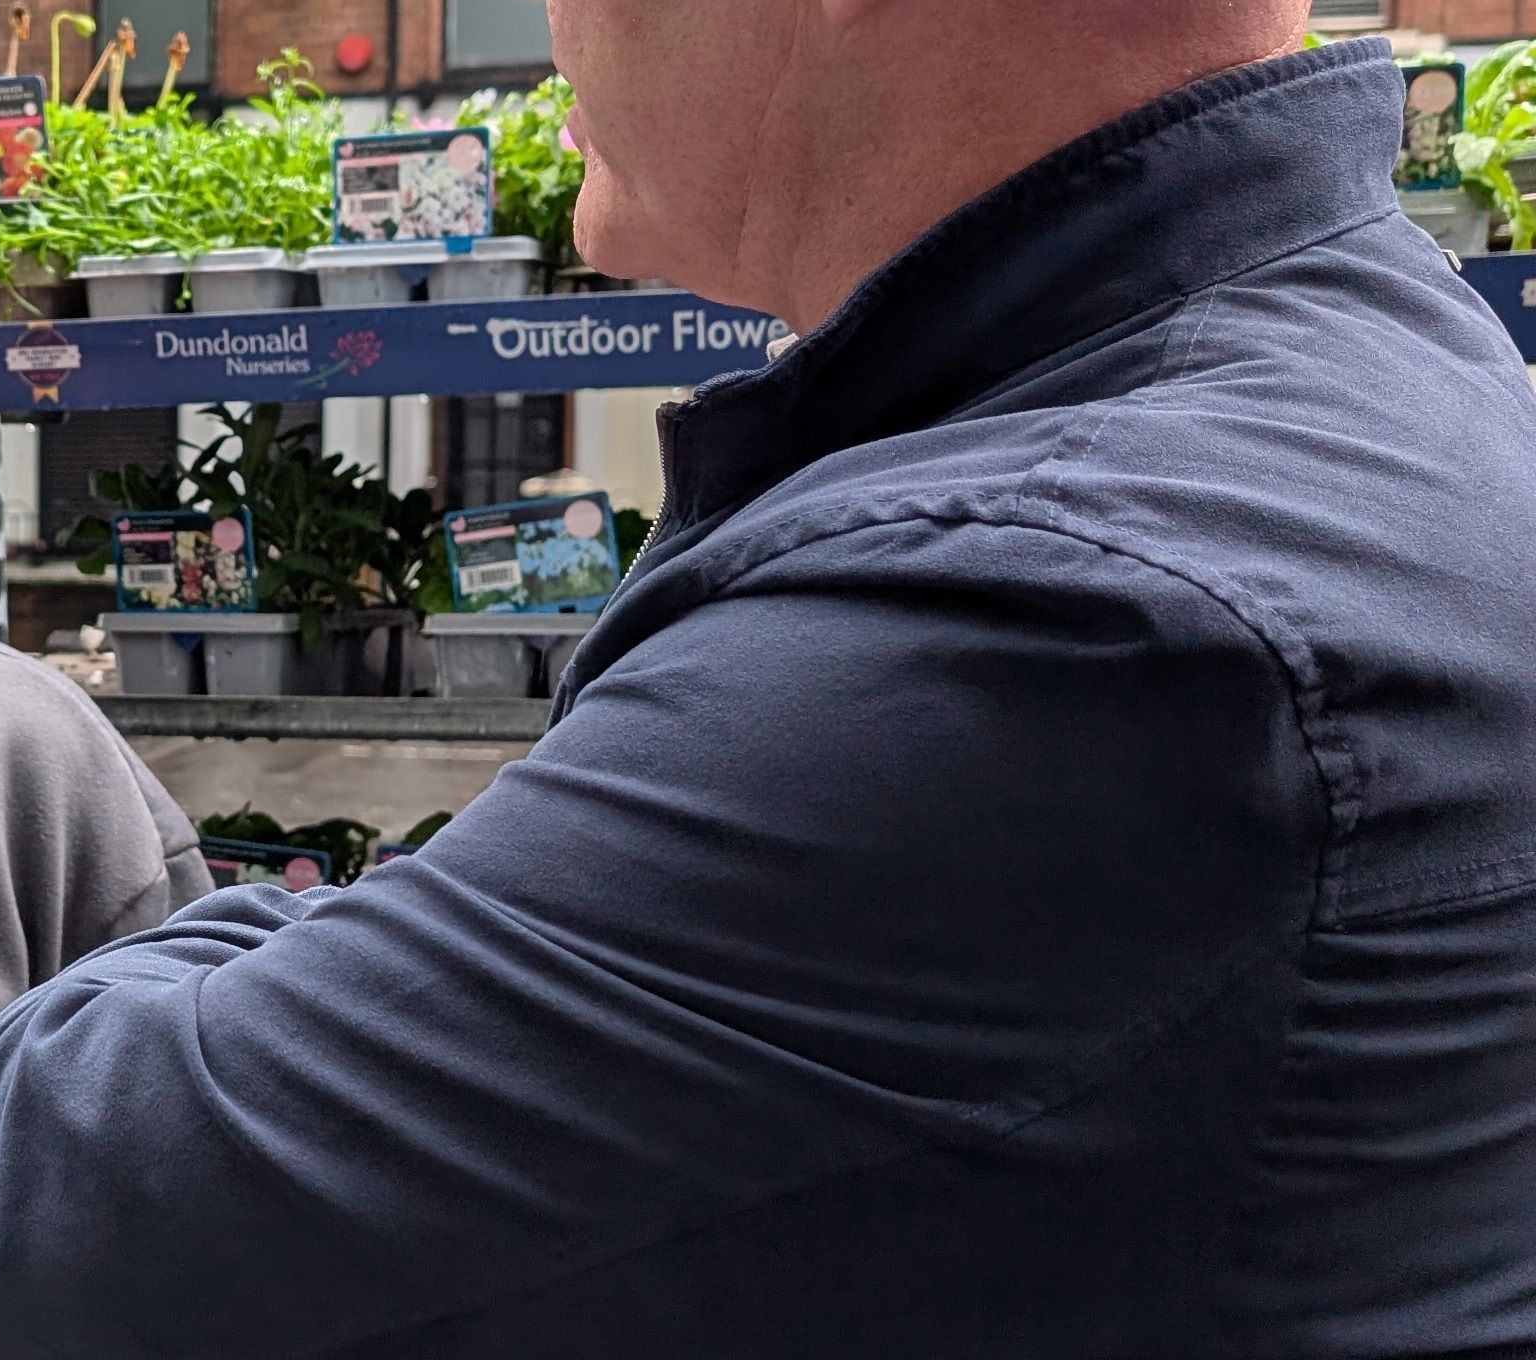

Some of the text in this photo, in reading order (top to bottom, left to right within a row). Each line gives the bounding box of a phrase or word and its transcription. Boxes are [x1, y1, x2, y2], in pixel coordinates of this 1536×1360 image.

[155, 324, 308, 358] Dundonald
[491, 315, 661, 359] Outdoor
[225, 355, 311, 376] Nurseries
